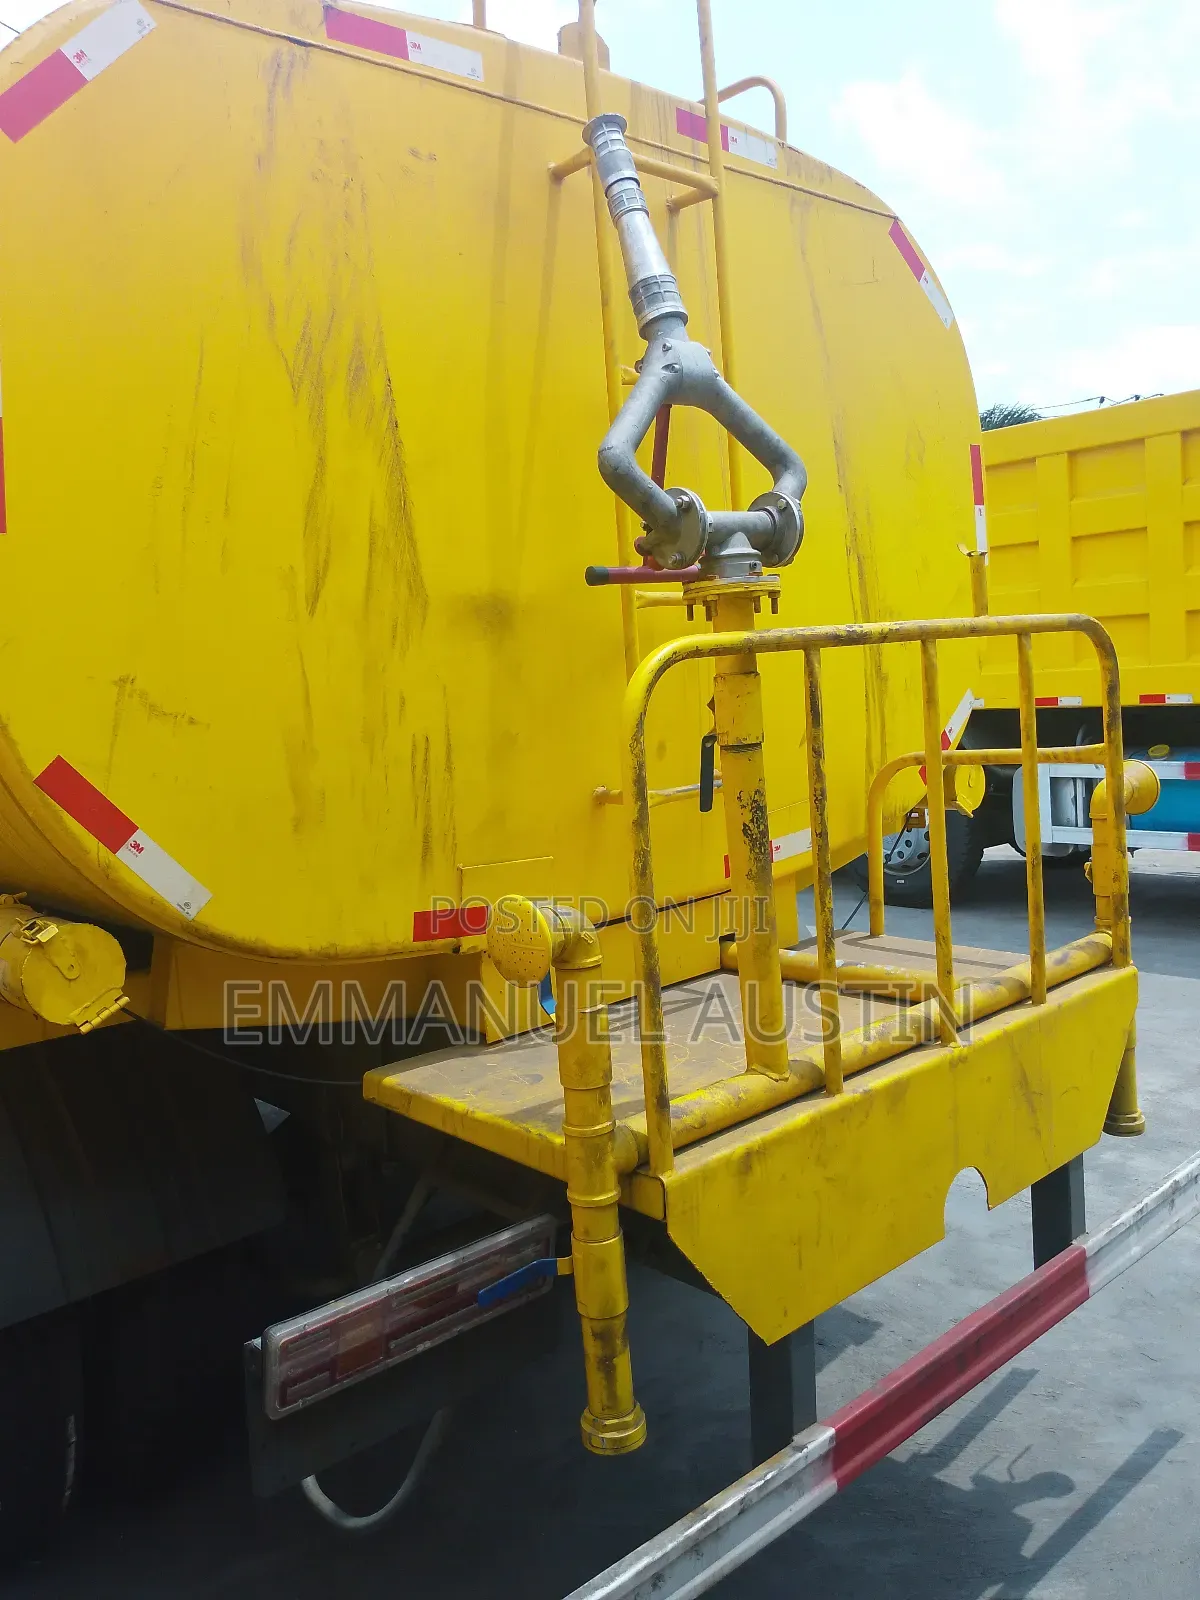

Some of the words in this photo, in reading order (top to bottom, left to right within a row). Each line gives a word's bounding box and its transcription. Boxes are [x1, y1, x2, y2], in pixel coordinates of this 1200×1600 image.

[410, 41, 421, 51] 3M
[73, 49, 88, 64] 3M
[130, 840, 145, 855] 3M
